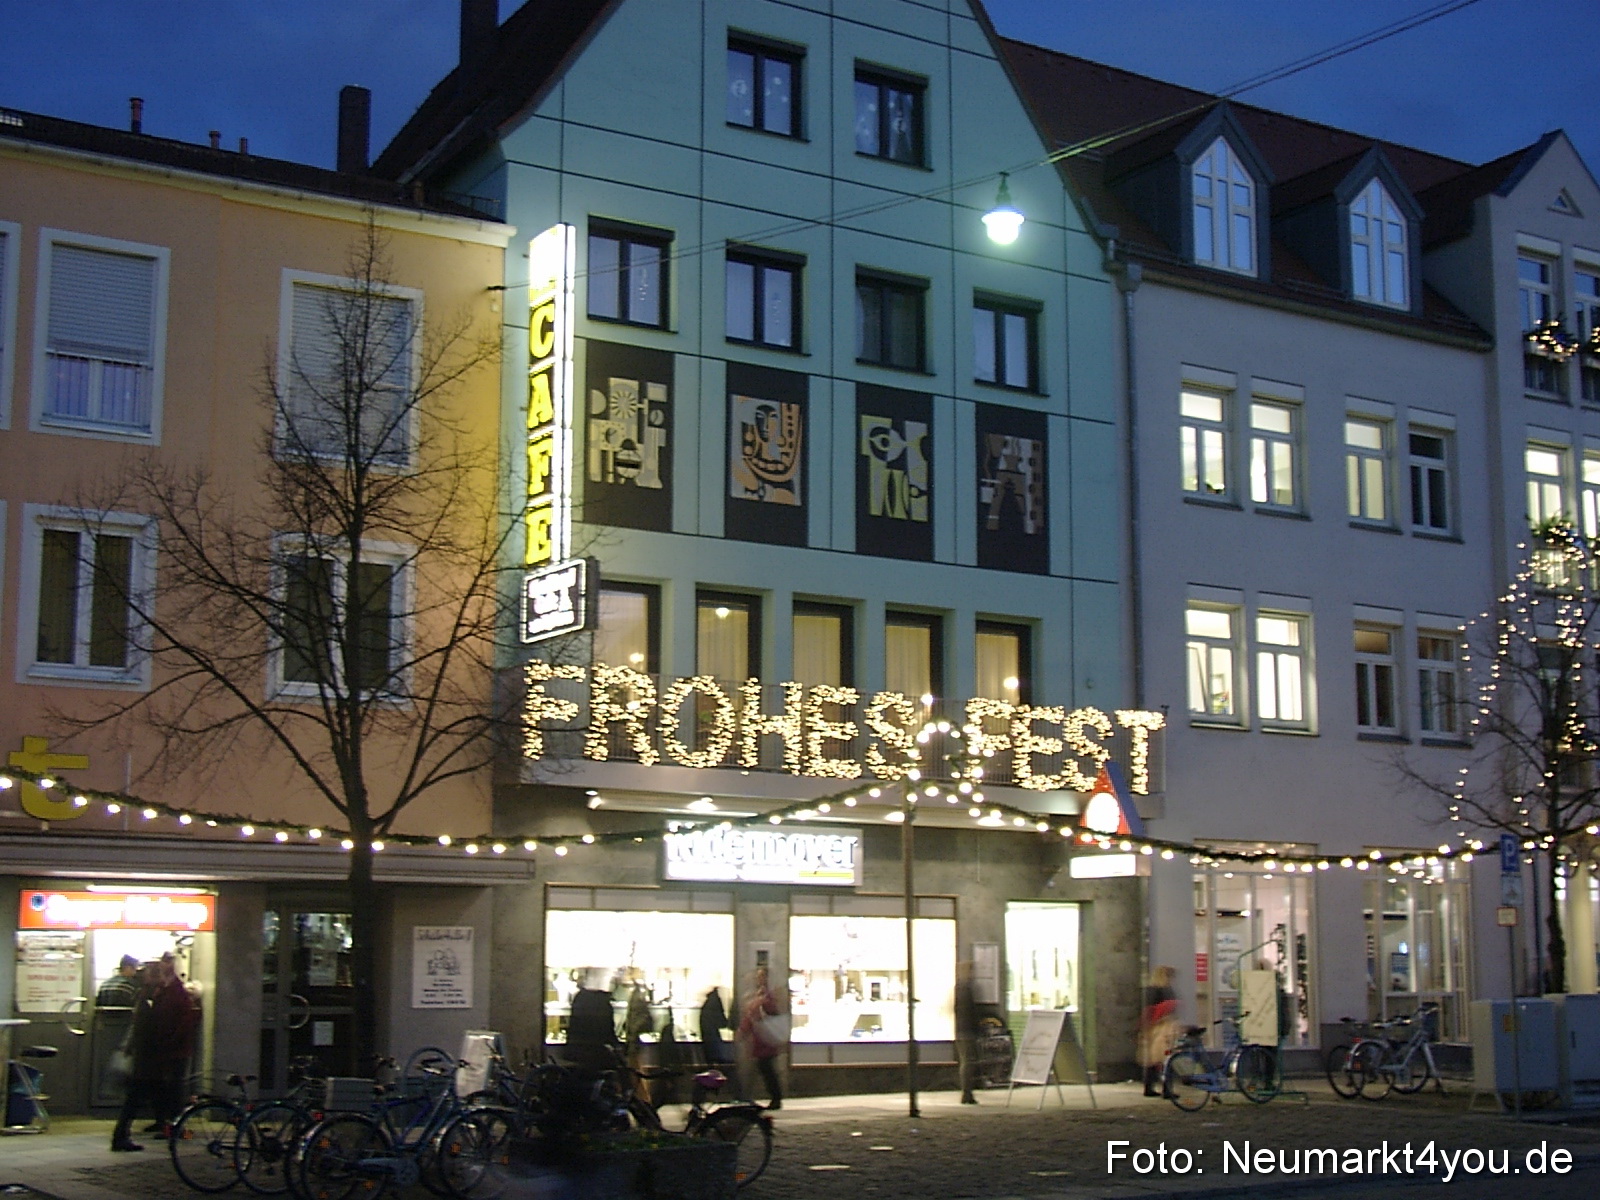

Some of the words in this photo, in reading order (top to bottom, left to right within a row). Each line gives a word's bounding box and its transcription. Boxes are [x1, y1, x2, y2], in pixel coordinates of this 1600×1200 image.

[526, 303, 555, 567] CAFE
[521, 659, 915, 780] FROHES
[965, 698, 1168, 796] FEST
